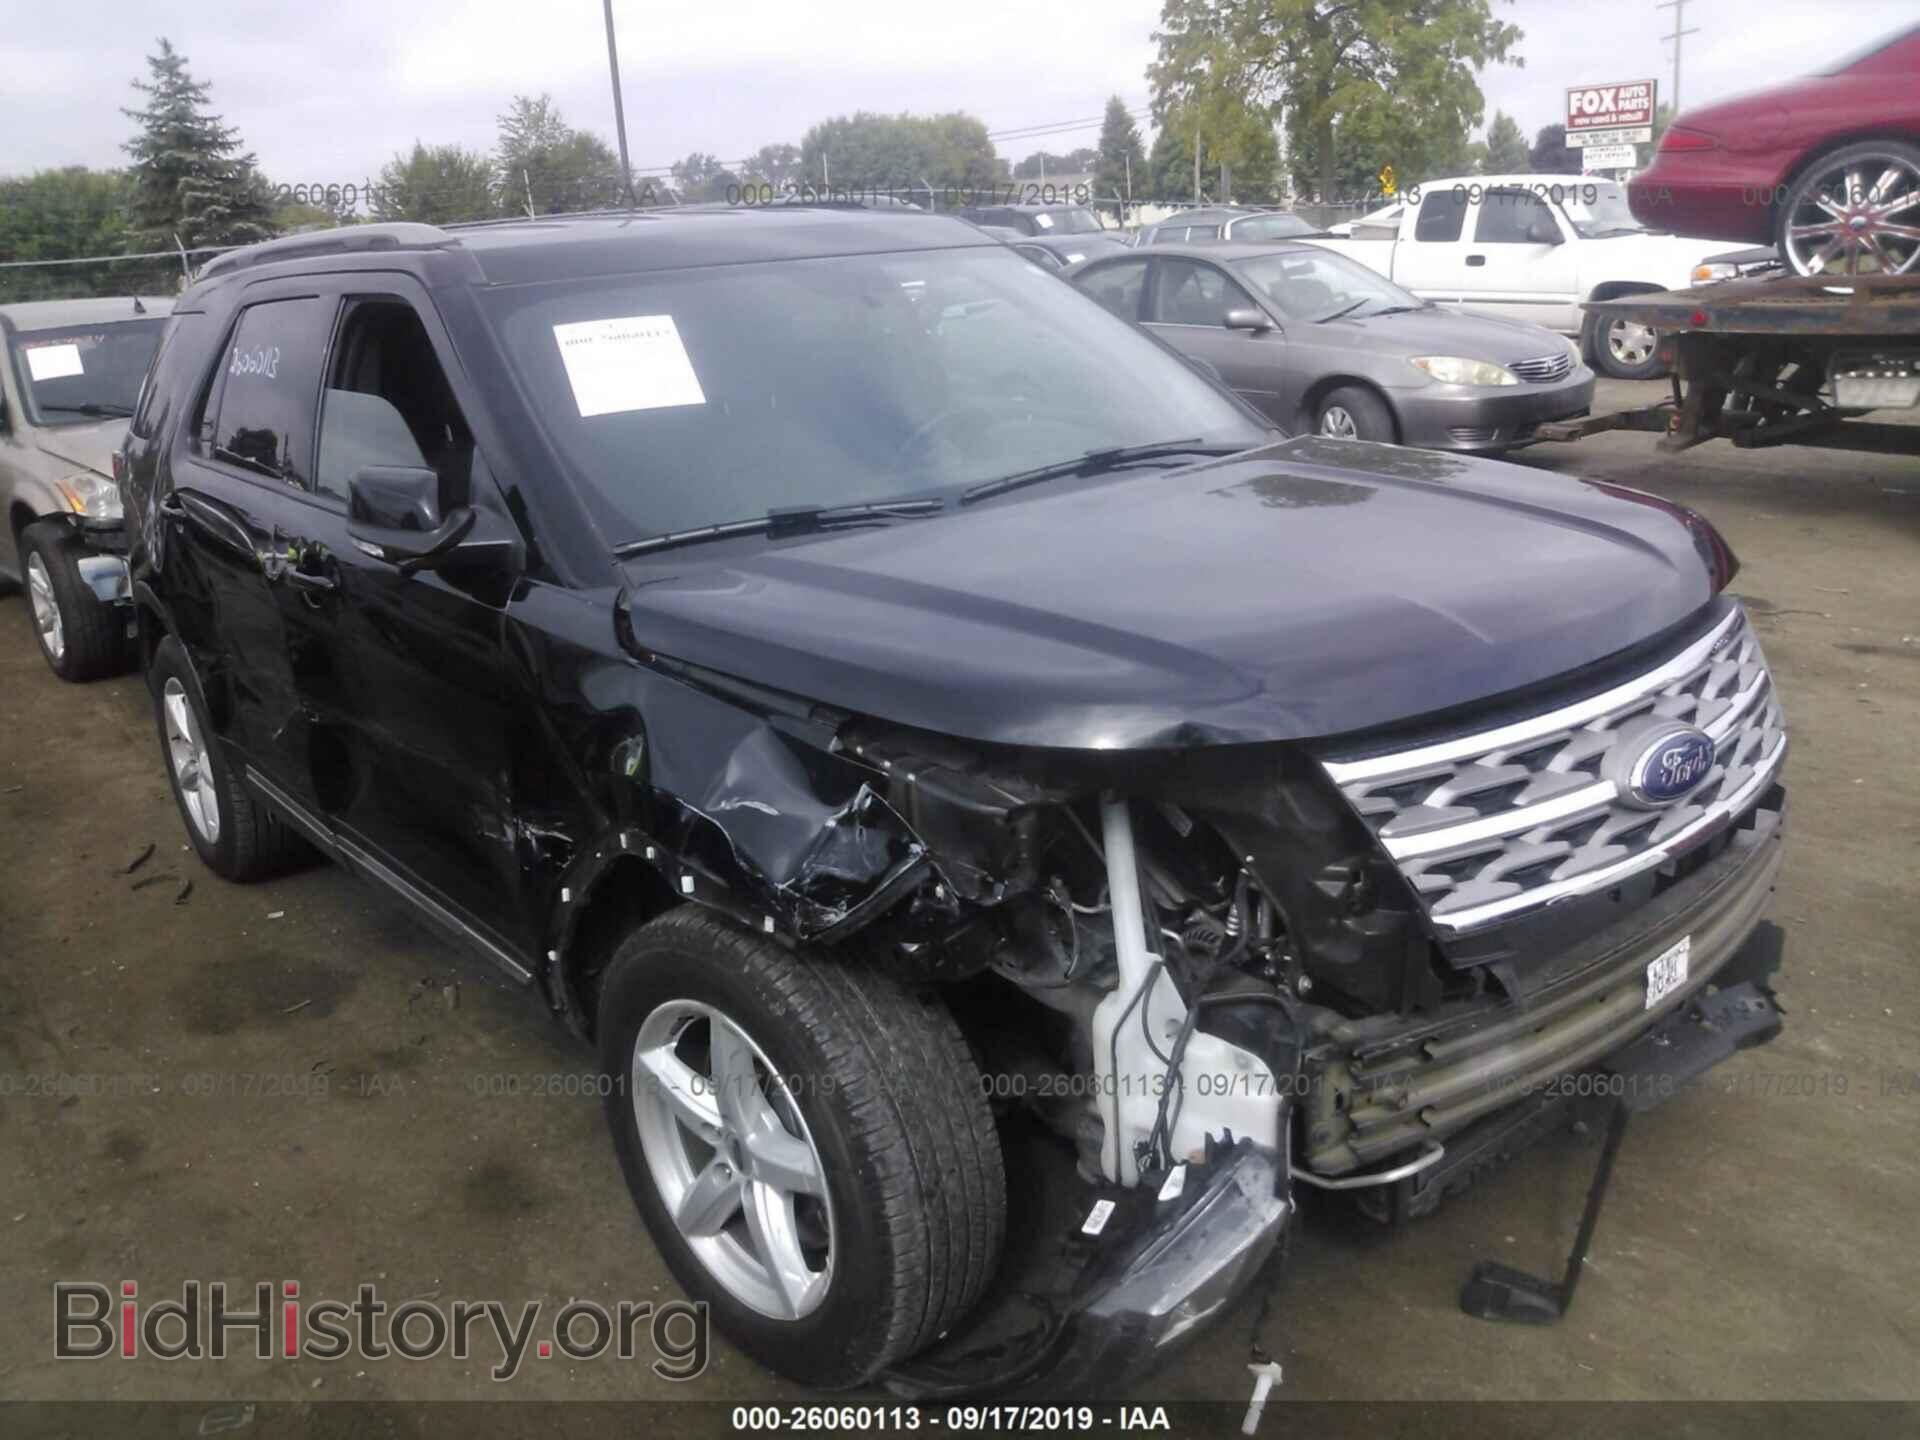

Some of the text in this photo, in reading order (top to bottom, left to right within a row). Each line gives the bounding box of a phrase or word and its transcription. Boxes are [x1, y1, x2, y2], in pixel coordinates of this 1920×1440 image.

[1570, 88, 1616, 116] FOX
[1619, 85, 1647, 99] AUTO
[1619, 97, 1649, 112] PARTS
[1659, 743, 1707, 787] Ford
